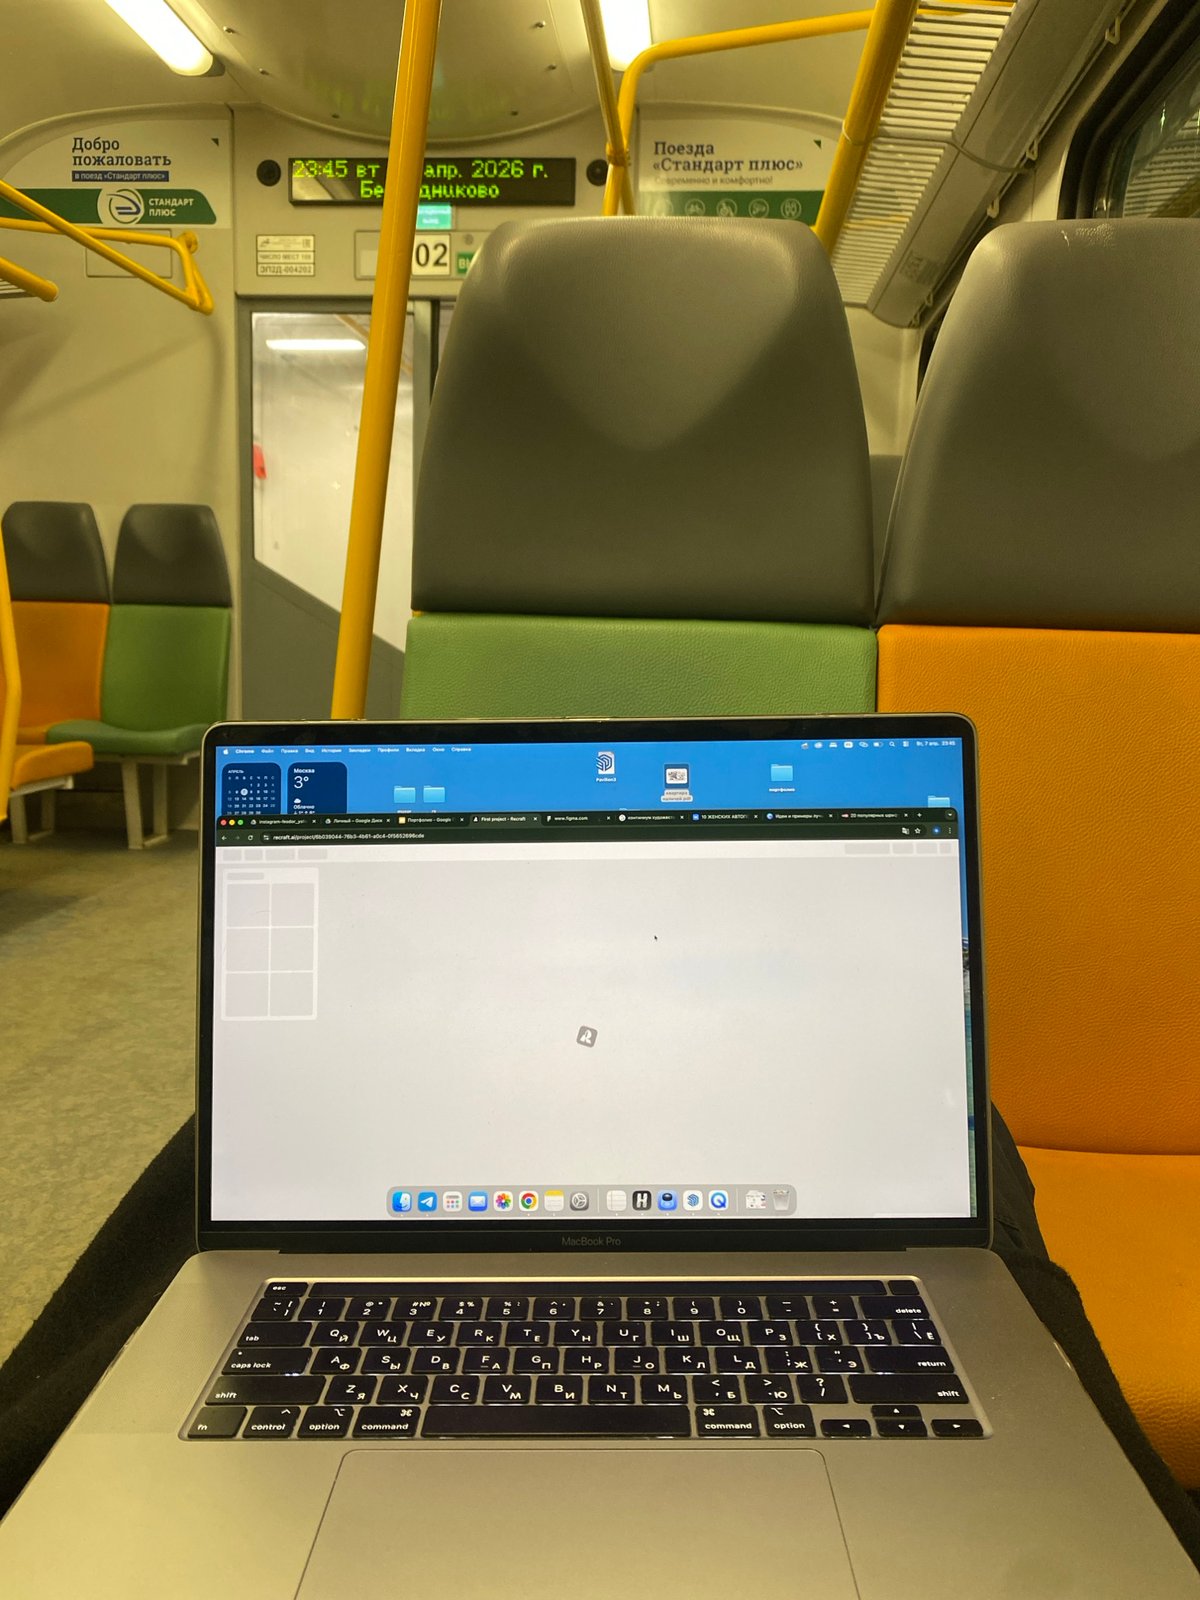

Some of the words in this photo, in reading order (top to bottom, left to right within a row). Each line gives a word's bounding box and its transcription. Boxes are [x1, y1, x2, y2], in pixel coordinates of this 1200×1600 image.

[72, 137, 120, 153] Добро
[654, 142, 714, 156] Поезда
[73, 156, 172, 166] пожаловать
[653, 158, 744, 175] «Стандарт
[749, 160, 803, 170] плюс»
[293, 160, 348, 178] 23:45
[356, 165, 380, 178] вт
[424, 164, 462, 180] апр.
[472, 160, 524, 178] 2026
[532, 164, 548, 178] г.
[104, 172, 140, 180] «Стандарт
[361, 180, 500, 199] Бедниково
[148, 198, 194, 206] СТАНДАРТ
[149, 208, 176, 216] ПЛЮС
[416, 243, 448, 267] 02
[294, 776, 309, 788] 3°
[562, 1236, 603, 1246] MacBook
[606, 1236, 621, 1246] Pro
[346, 1385, 356, 1393] Z
[774, 1422, 805, 1430] option
